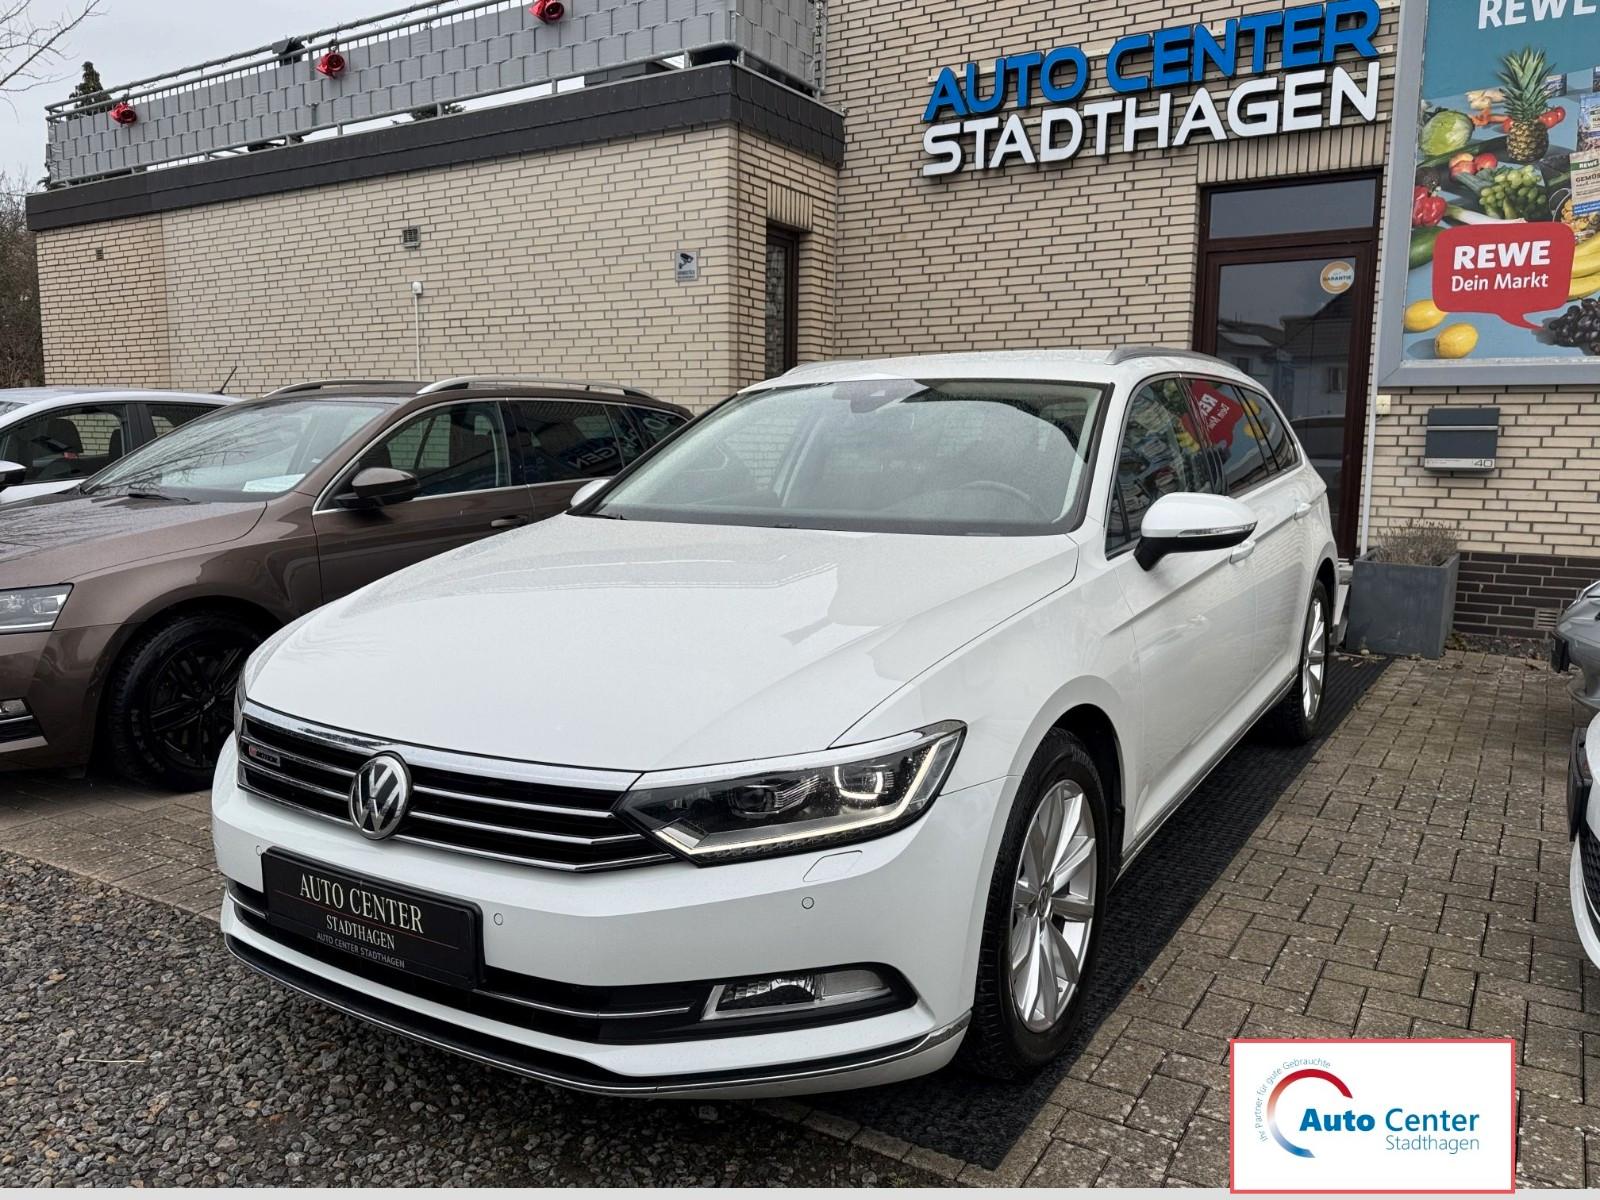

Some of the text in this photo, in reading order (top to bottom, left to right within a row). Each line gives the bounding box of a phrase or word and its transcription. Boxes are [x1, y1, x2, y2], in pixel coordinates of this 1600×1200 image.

[922, 0, 1381, 122] AUTO CENTER
[922, 61, 1380, 177] STADTHAGEN
[1453, 240, 1551, 270] REWE
[1451, 272, 1549, 292] Dein Markt
[300, 873, 424, 934] AUTO CENTER
[317, 932, 405, 969] AUTO CENTER STADTHAGEN
[326, 914, 395, 950] STADTHAGEN
